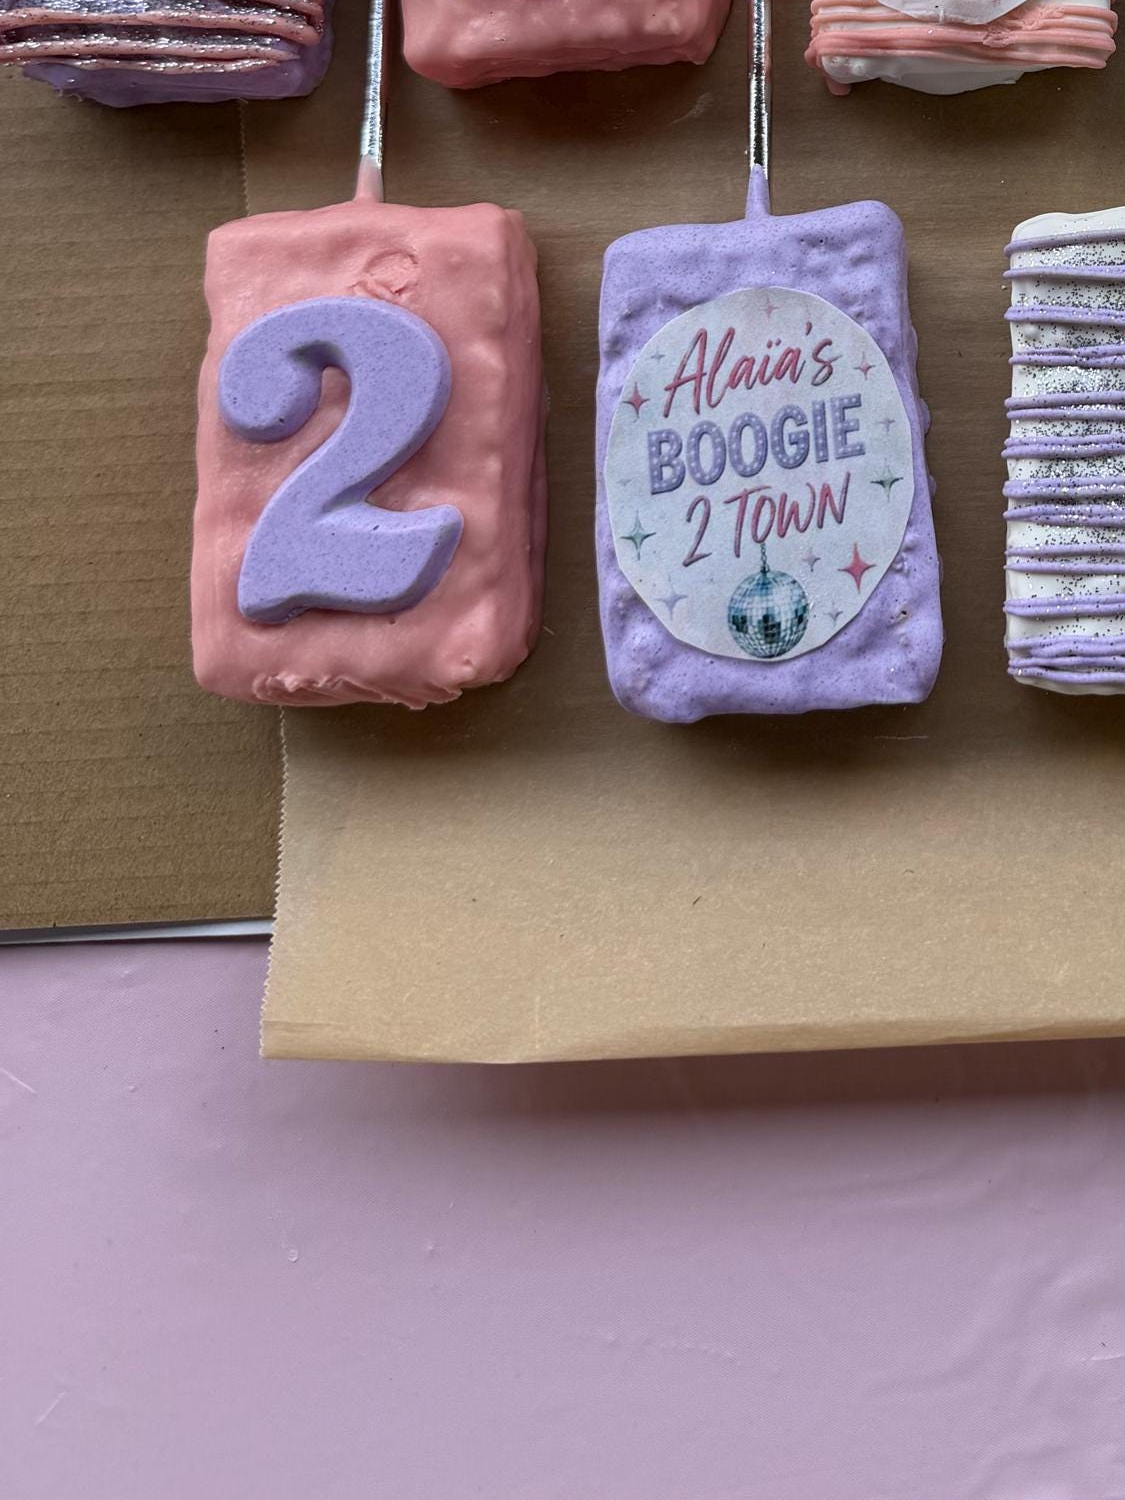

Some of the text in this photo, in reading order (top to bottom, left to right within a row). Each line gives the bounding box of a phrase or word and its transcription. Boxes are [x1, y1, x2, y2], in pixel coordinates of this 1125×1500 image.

[219, 295, 465, 625] 2
[646, 392, 867, 497] BOOGIE
[682, 471, 852, 568] 2 TOWN
